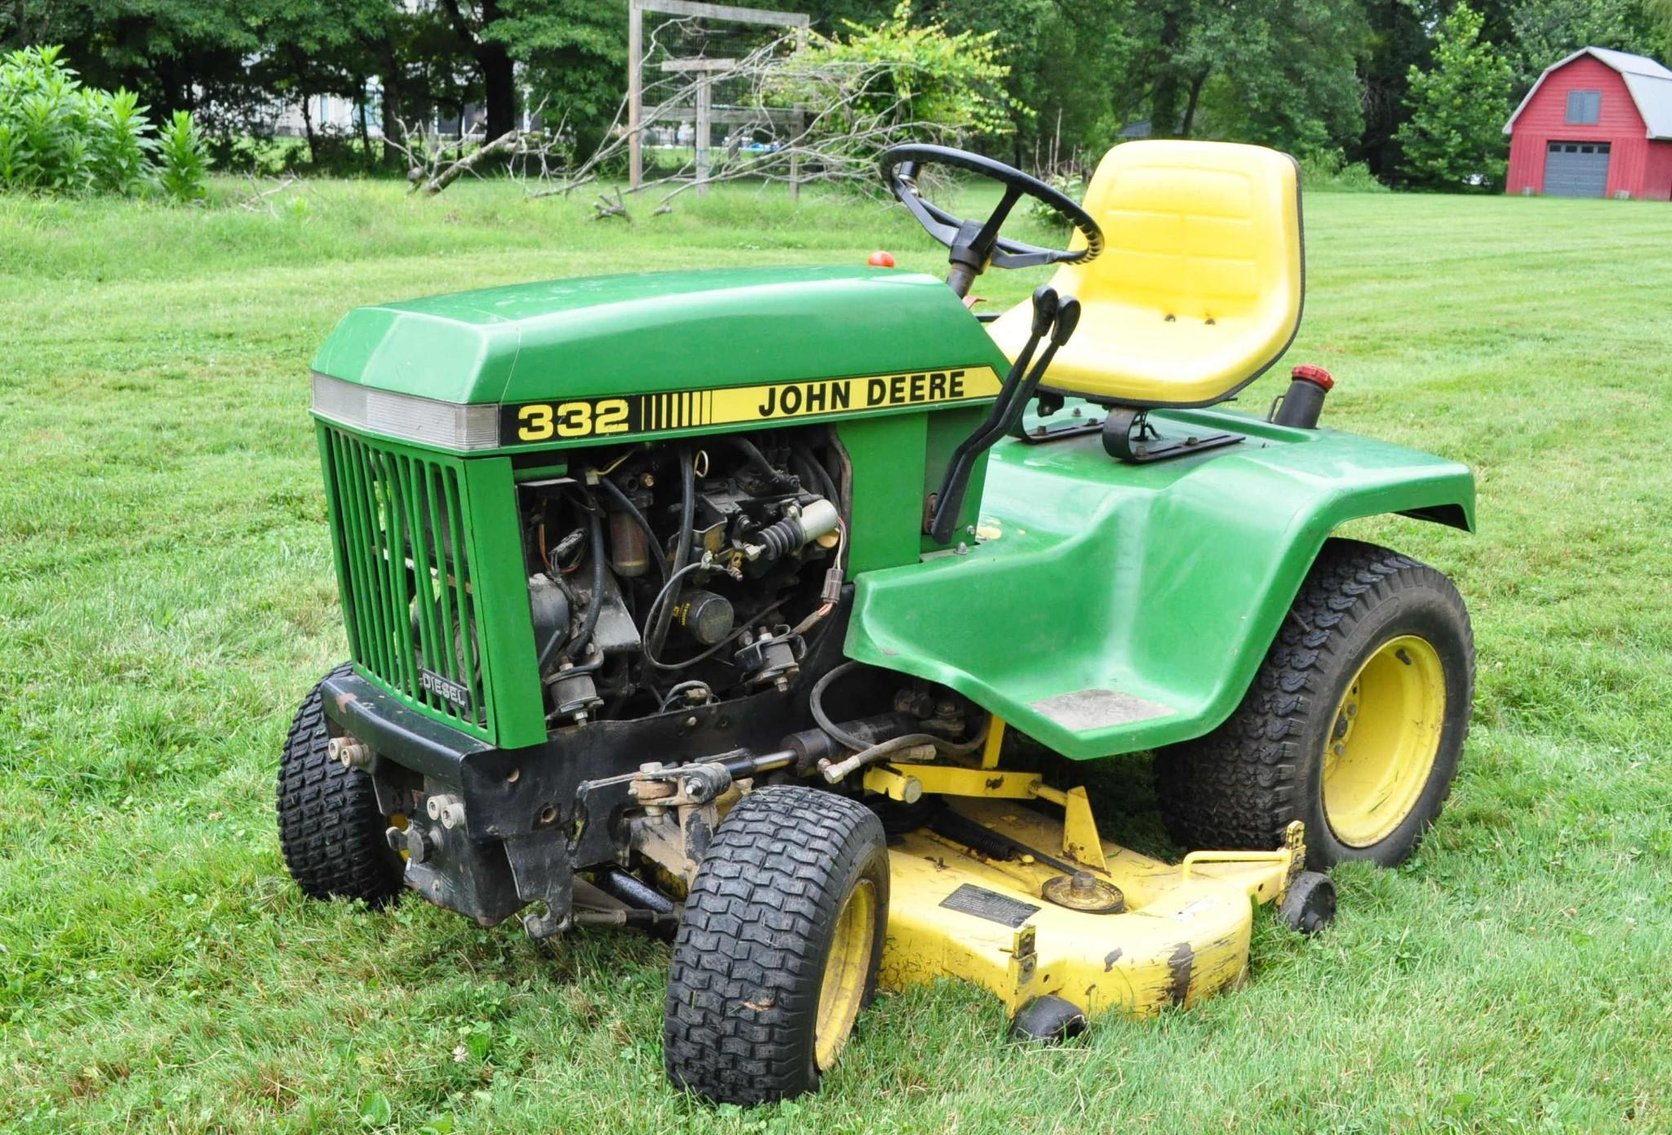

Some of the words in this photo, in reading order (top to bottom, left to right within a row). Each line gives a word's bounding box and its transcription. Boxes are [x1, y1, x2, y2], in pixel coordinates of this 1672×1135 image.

[758, 381, 850, 417] JOHN
[867, 371, 965, 406] DEERE
[518, 399, 629, 441] 332
[422, 672, 466, 706] DIESEL
